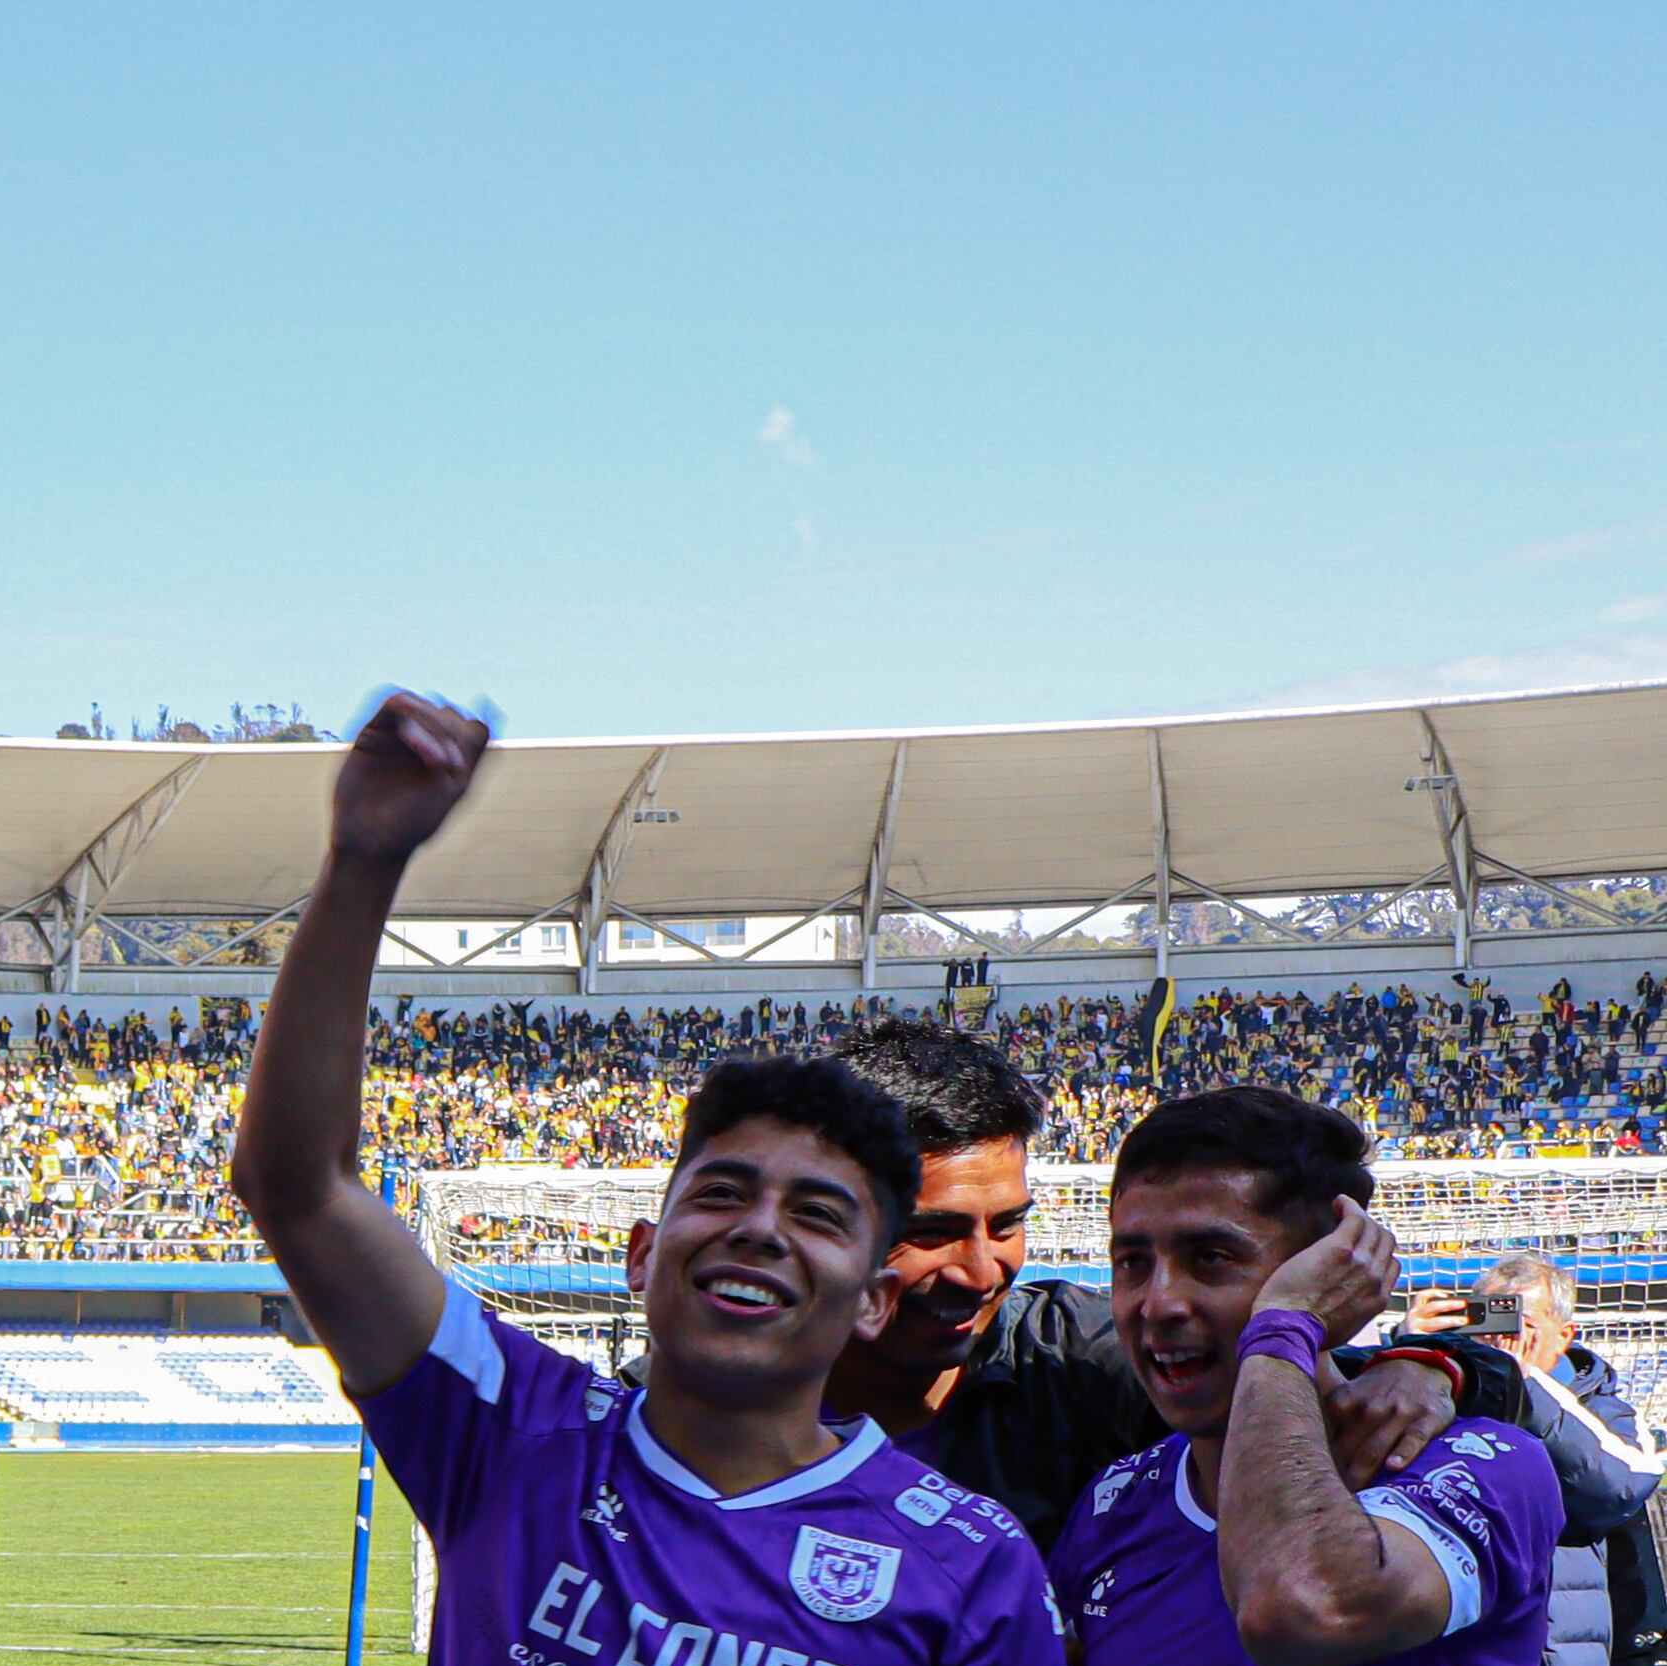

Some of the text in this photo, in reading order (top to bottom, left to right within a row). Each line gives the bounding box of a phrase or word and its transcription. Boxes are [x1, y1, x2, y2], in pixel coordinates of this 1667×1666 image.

[918, 1473, 1024, 1539] Del Sur
[528, 1562, 604, 1656] EL
